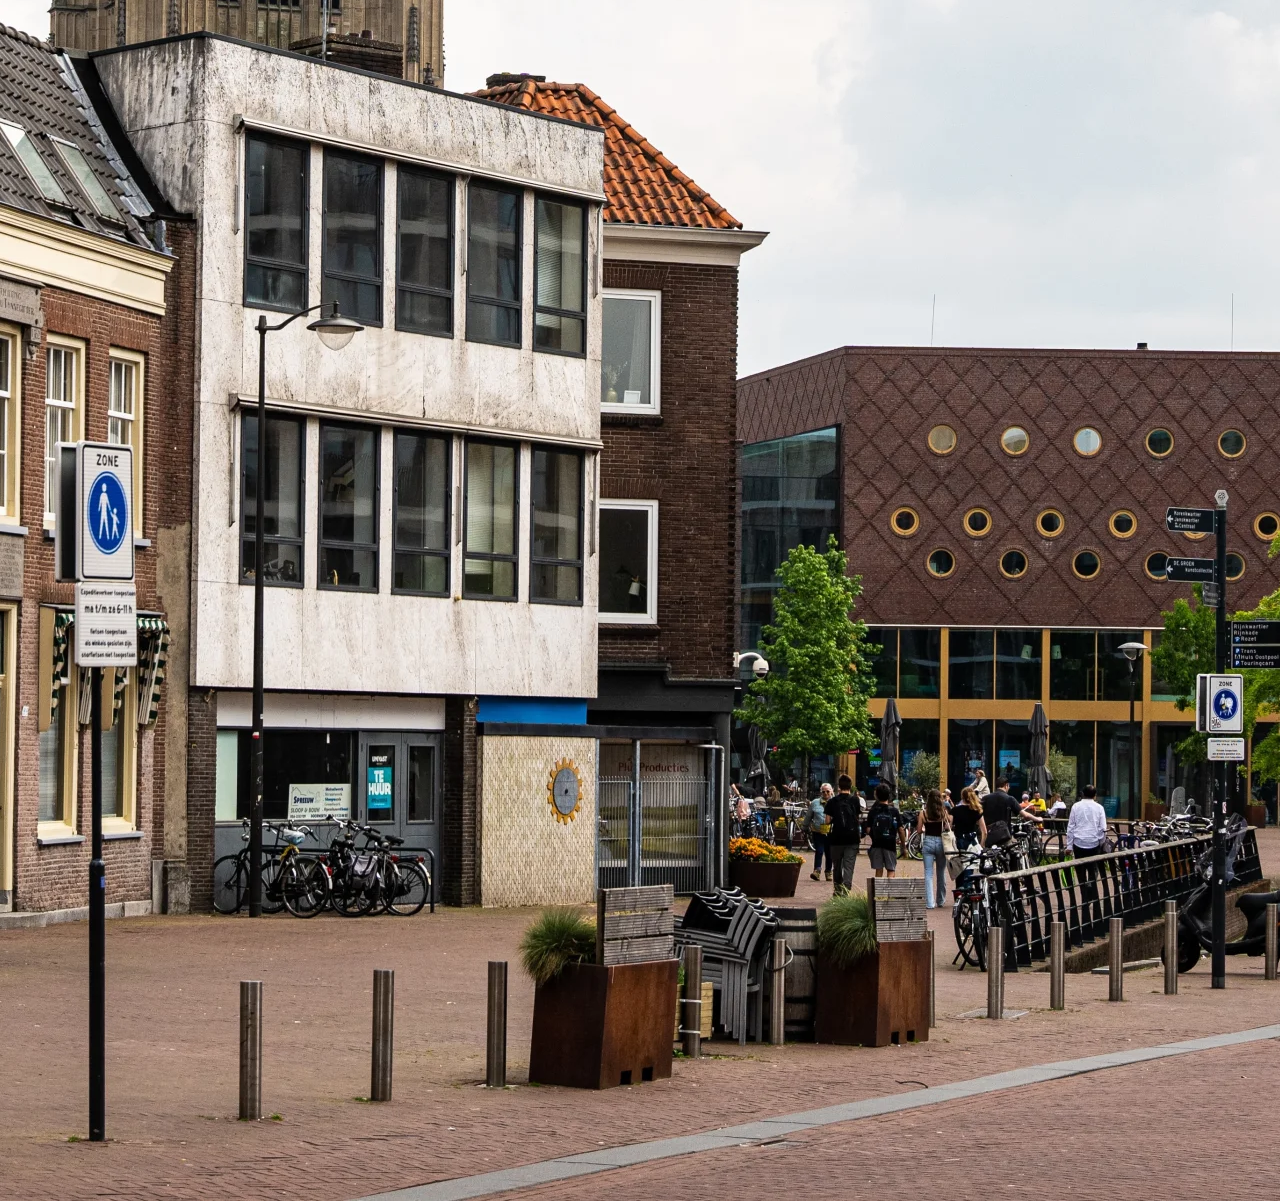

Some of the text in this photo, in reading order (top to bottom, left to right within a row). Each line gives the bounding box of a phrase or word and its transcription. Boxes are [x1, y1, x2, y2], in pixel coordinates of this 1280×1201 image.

[96, 454, 119, 467] ZONE
[80, 589, 136, 598] Expeditieverkeer toegestaan
[84, 605, 94, 613] ma
[95, 604, 107, 614] t/m
[108, 605, 116, 613] za
[117, 604, 128, 614] 6-11
[1233, 624, 1269, 632] Rijnkwartier
[640, 762, 690, 773] Producties
[374, 769, 385, 783] TE
[368, 782, 392, 796] HUUR
[293, 796, 314, 804] SPREEUW
